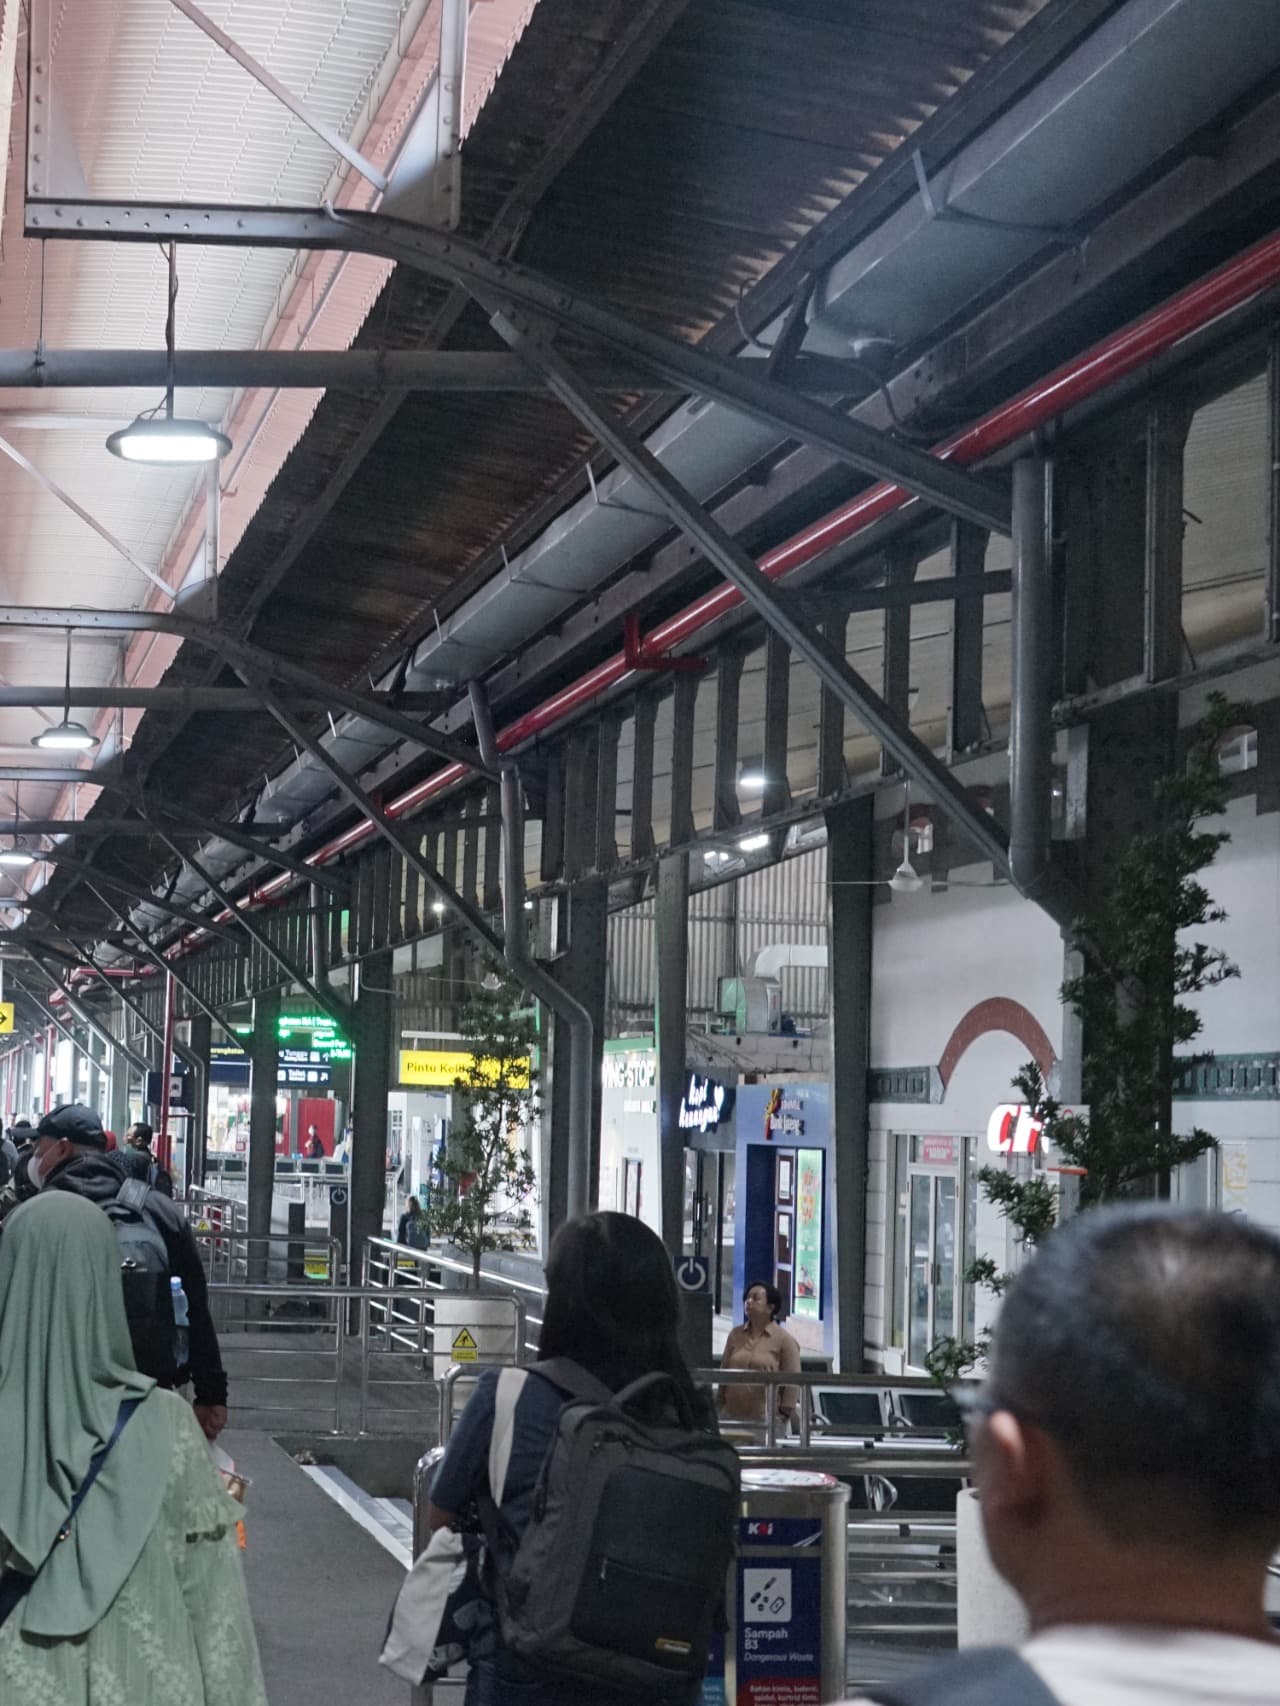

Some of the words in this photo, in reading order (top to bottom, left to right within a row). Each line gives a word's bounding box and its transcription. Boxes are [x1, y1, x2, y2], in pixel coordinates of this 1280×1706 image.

[210, 1047, 245, 1056] erangkatan
[407, 1062, 436, 1073] Pintu
[744, 1627, 789, 1641] Sampah
[744, 1639, 759, 1650] B3
[744, 1652, 787, 1663] Dangerous
[789, 1652, 814, 1662] Waste
